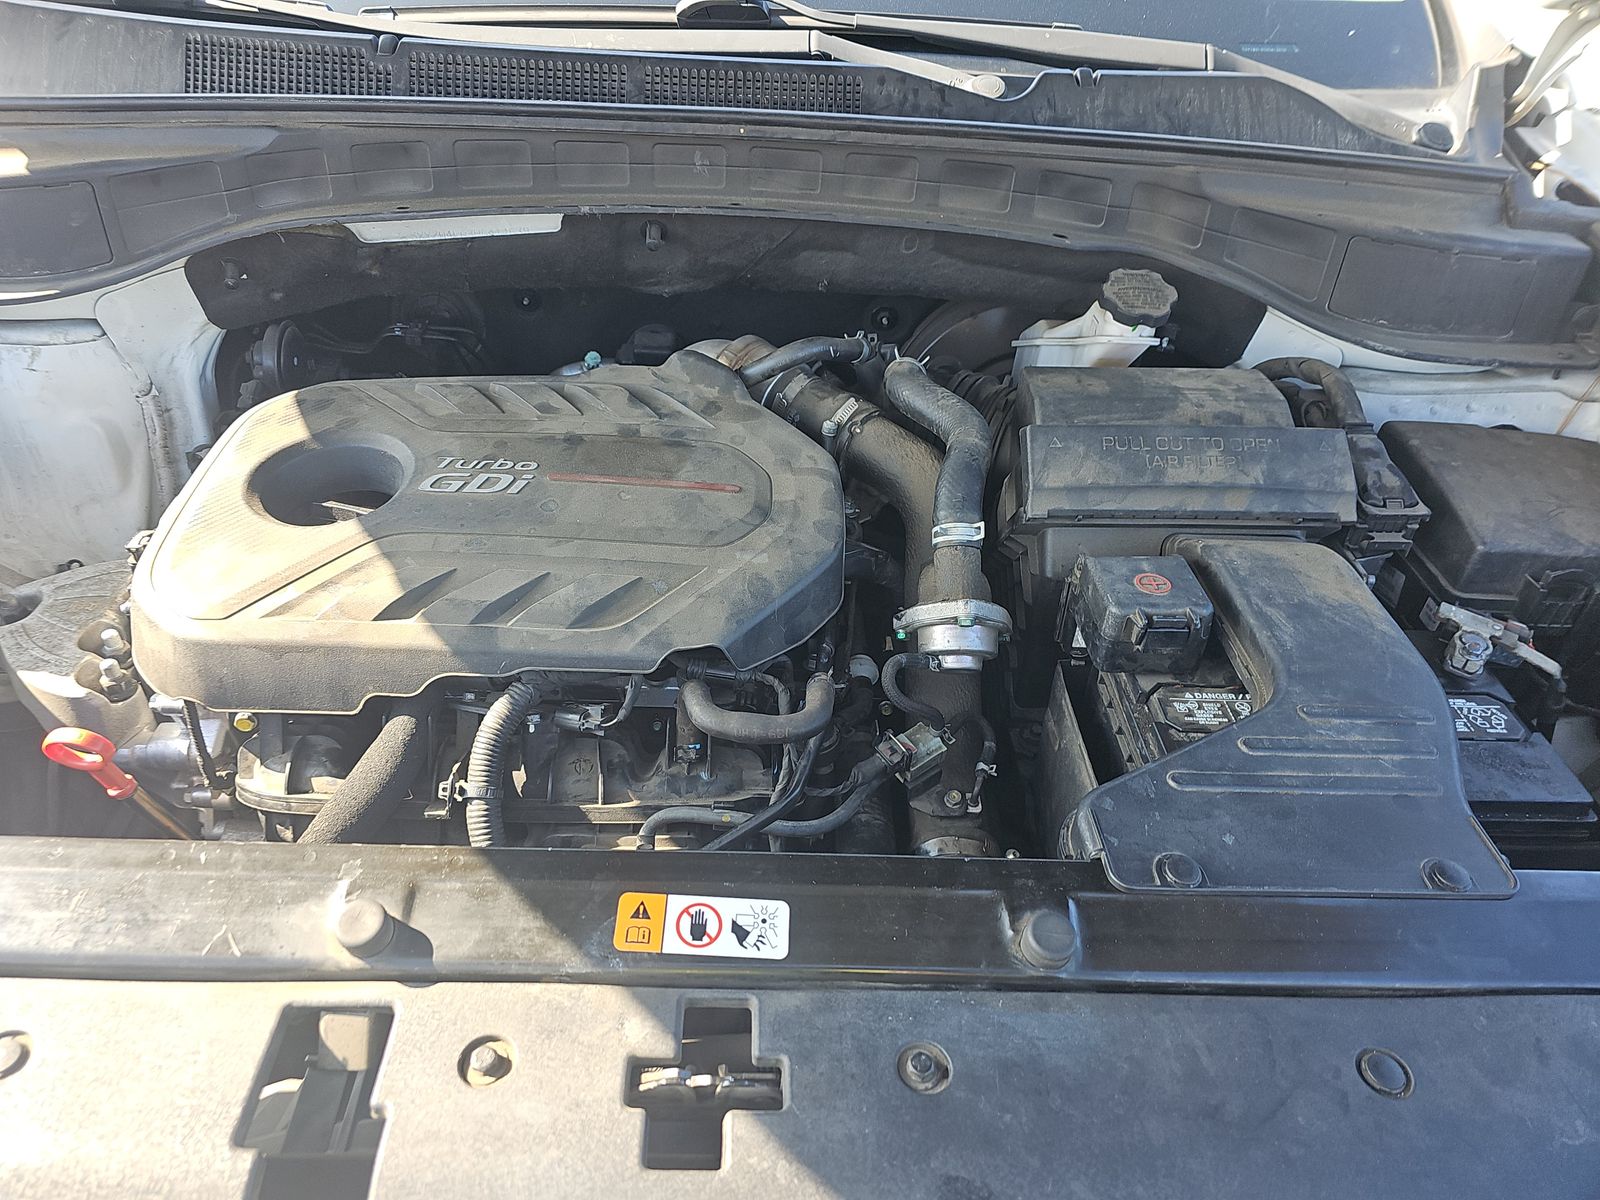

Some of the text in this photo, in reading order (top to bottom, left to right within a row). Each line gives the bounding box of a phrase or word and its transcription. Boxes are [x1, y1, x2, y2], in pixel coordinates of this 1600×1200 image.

[1102, 436, 1281, 453] PULL OUT TO OPEN
[437, 456, 540, 470] Turbo
[418, 473, 535, 494] GDi
[1194, 692, 1236, 700] DANGER
